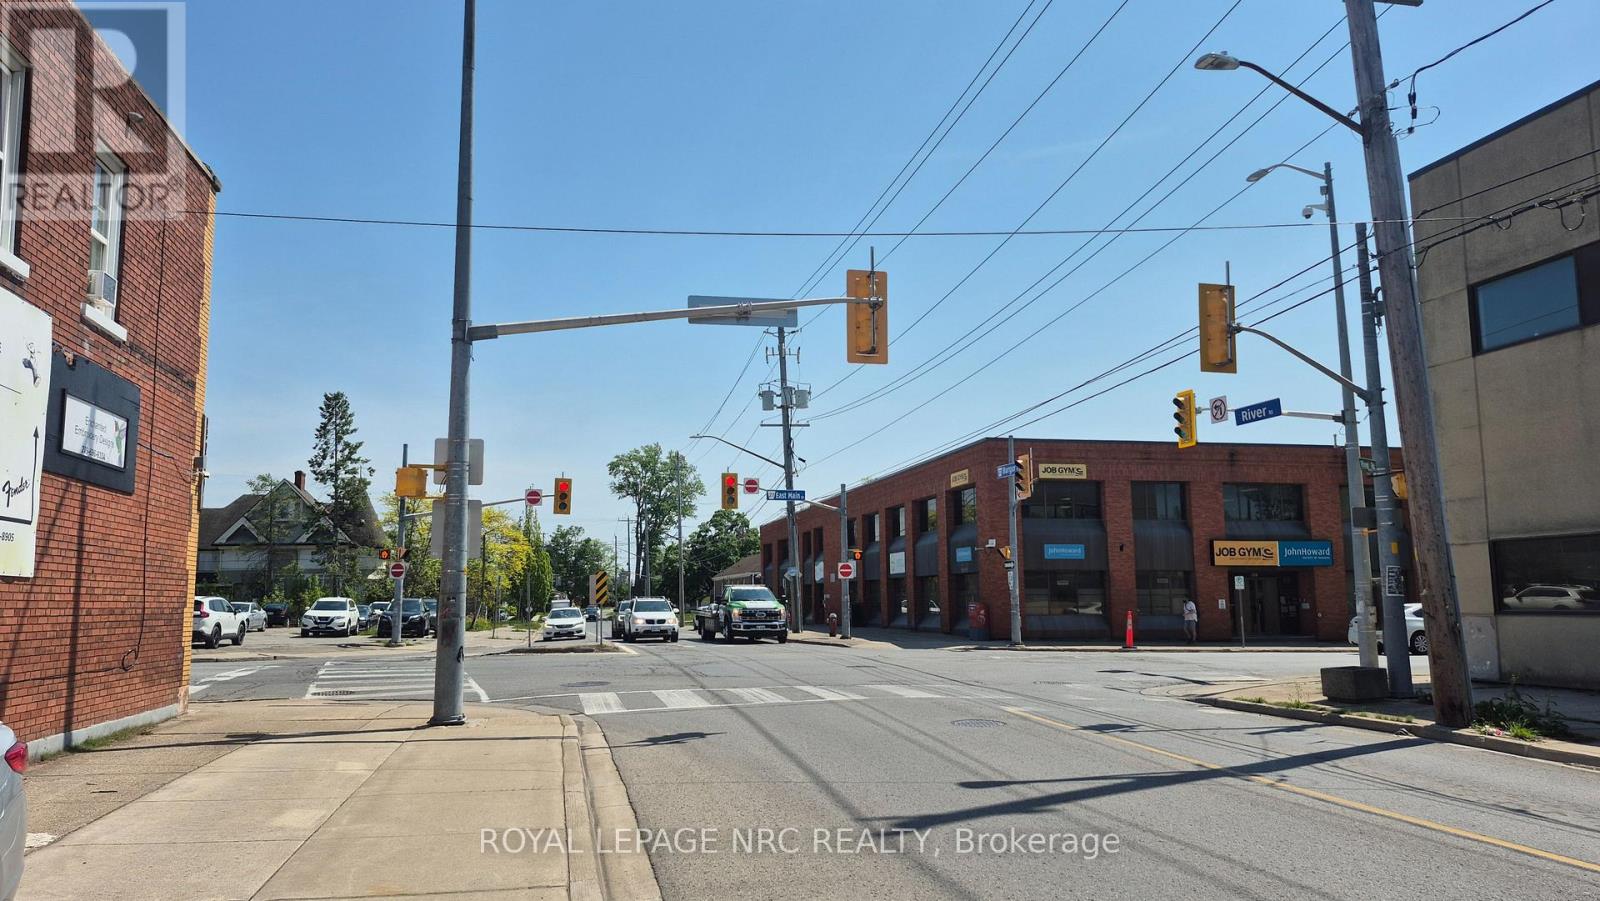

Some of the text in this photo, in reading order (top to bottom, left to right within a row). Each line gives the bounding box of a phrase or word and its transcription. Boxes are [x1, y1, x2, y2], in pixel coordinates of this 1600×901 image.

[1241, 407, 1267, 422] River
[2, 476, 30, 508] Fender
[788, 491, 800, 499] Main
[1215, 547, 1237, 557] JOB
[1284, 547, 1331, 557] JohnHoward
